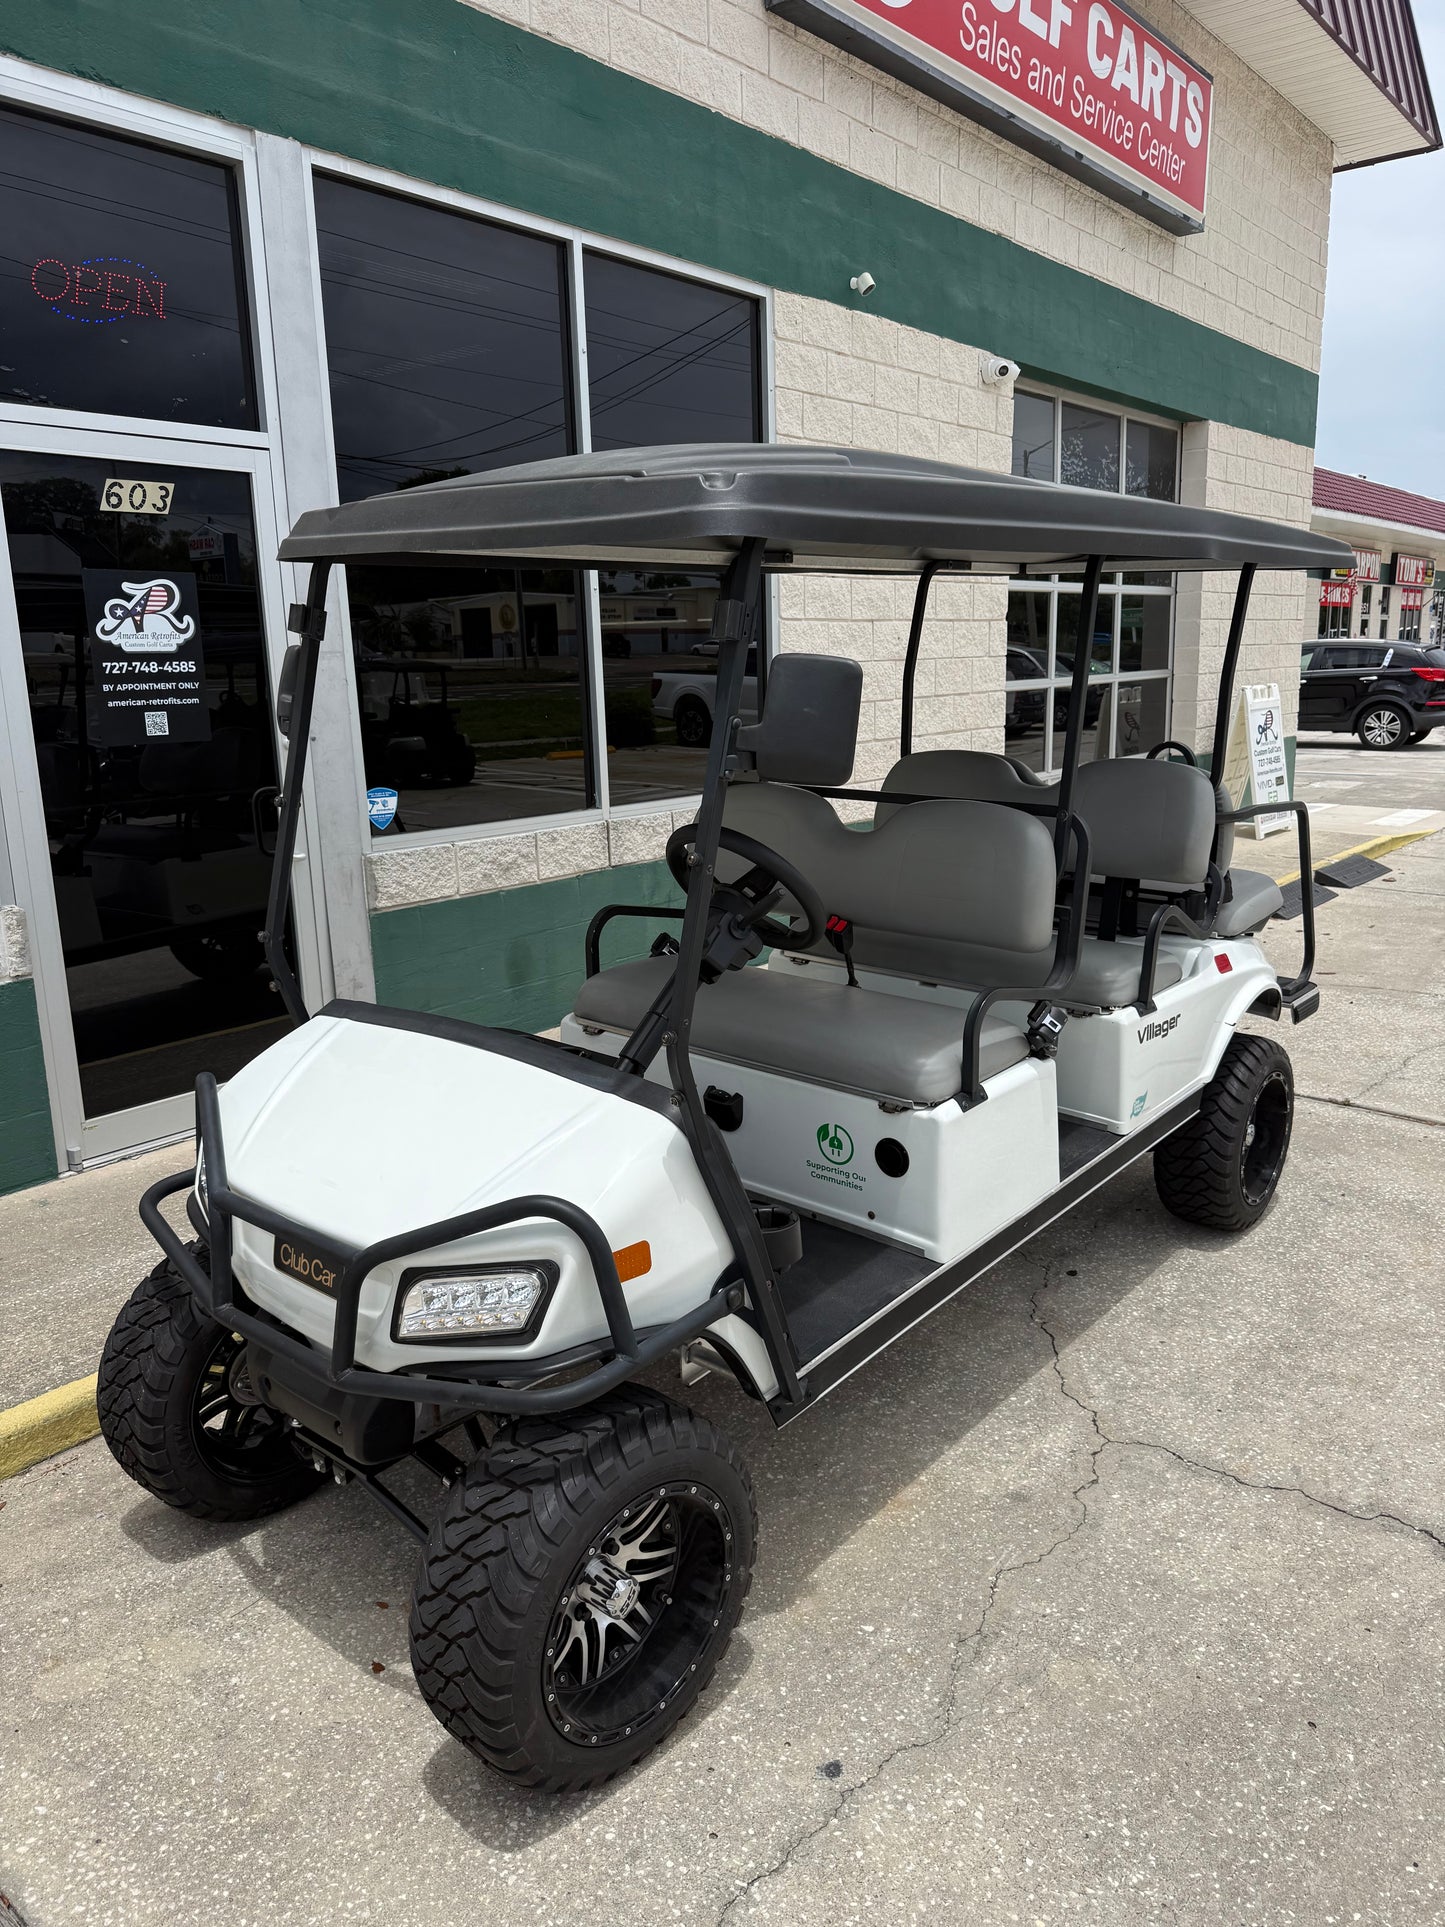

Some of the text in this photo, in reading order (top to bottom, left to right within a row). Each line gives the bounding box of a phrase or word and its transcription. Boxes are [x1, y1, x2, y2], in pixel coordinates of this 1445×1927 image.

[1087, 2, 1204, 148] CARTS
[960, 1, 1186, 184] Sales and Service Center
[31, 258, 168, 319] OPEN
[105, 481, 170, 512] 603
[1399, 557, 1424, 583] TOM'S
[115, 630, 181, 641] American Retrofits
[102, 661, 197, 674] 727-748-4585
[102, 682, 200, 692] BY APPOINTMENT ONLY
[107, 697, 200, 708] american-retrofits.com
[1137, 1013, 1182, 1044] Villager
[806, 1159, 850, 1179] Supporting
[810, 1171, 863, 1191] Communities
[280, 1243, 337, 1288] Club Car
